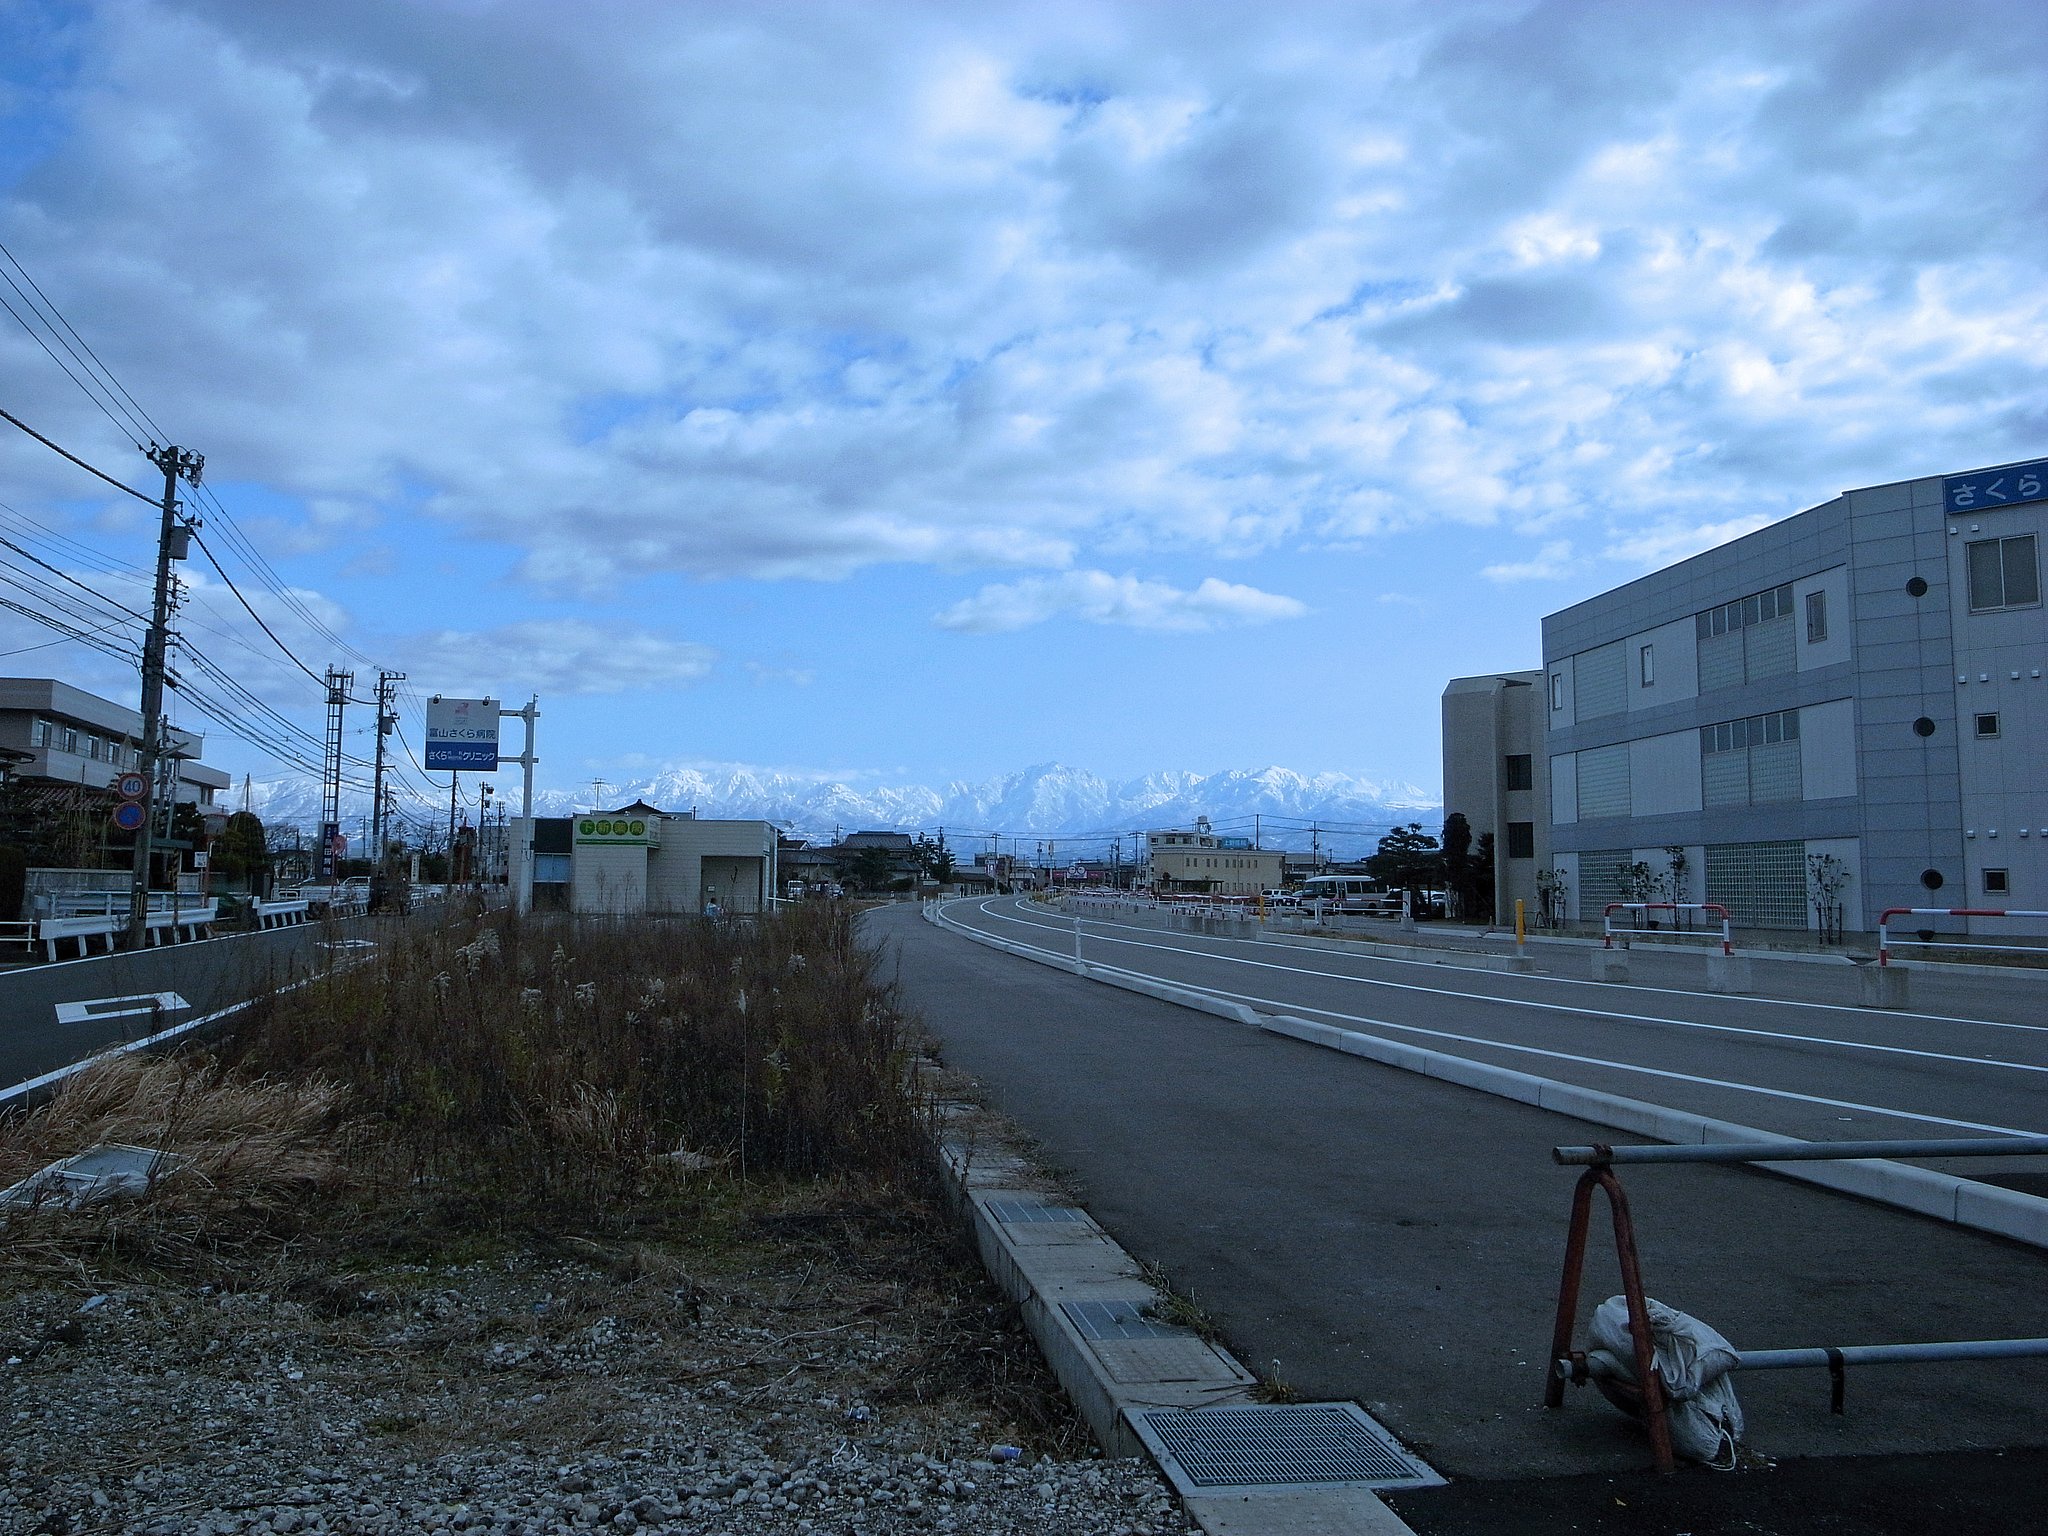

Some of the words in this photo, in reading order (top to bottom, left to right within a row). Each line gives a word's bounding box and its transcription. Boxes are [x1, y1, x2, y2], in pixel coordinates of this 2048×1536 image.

[1953, 474, 2041, 506] さくら
[429, 728, 496, 739] 富山さくら病院
[124, 780, 141, 793] 40
